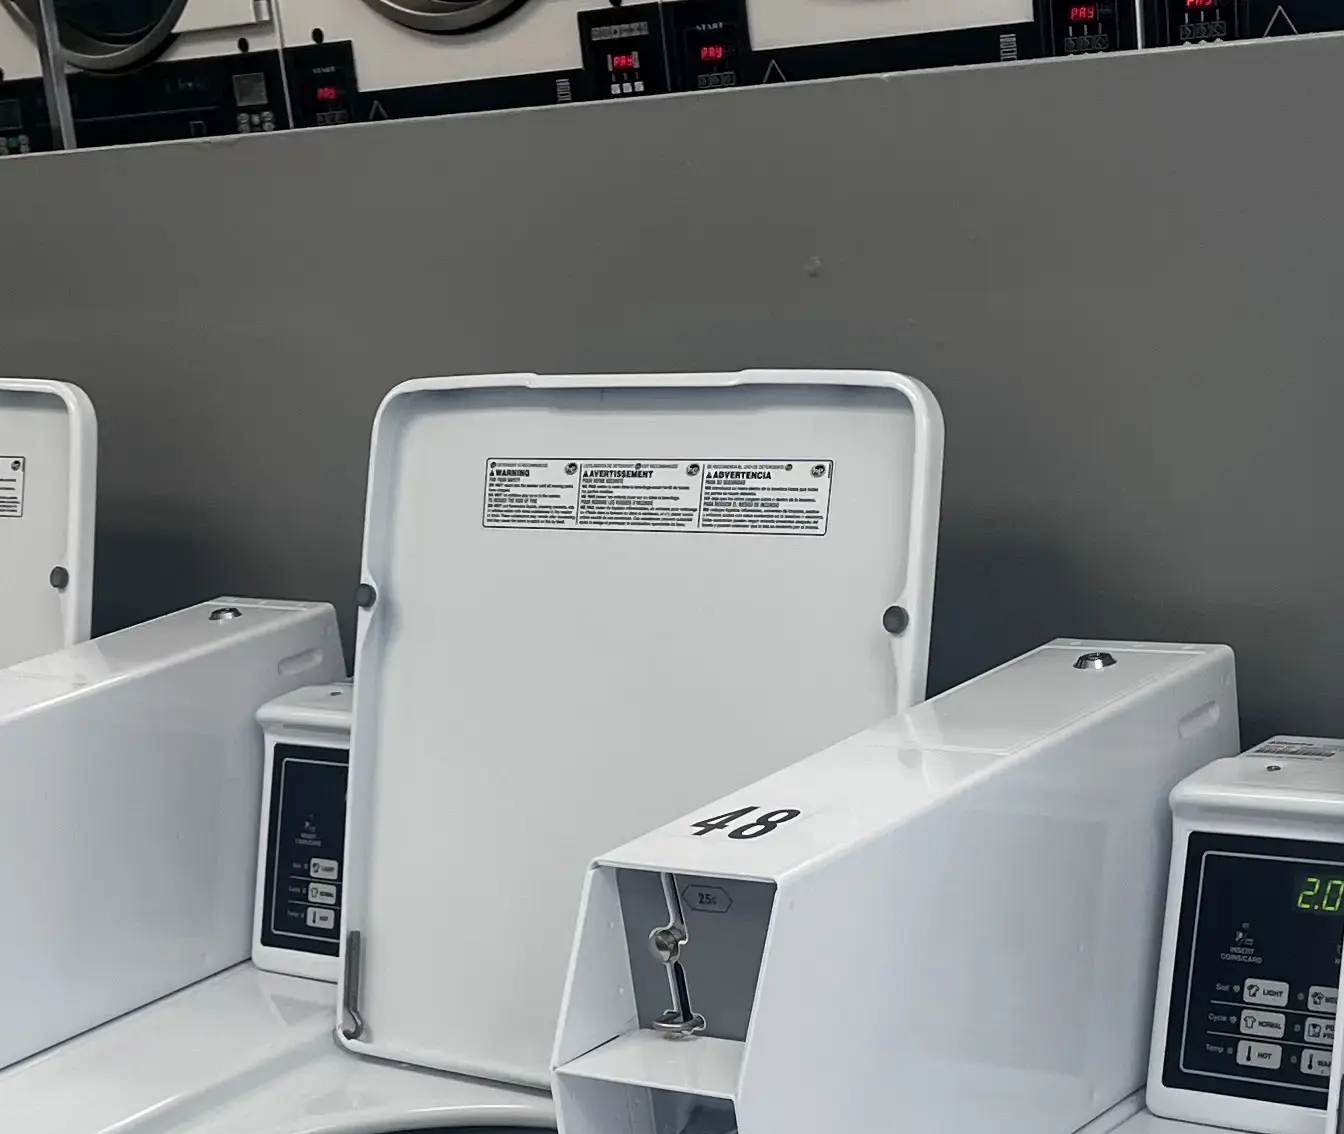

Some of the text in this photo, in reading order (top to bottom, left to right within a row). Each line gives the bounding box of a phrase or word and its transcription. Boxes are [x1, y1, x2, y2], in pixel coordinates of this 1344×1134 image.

[589, 469, 654, 479] AVERTISSEMENT
[713, 471, 772, 480] ADVERTENCIA
[690, 805, 802, 840] 48
[1257, 1051, 1273, 1060] HOT
